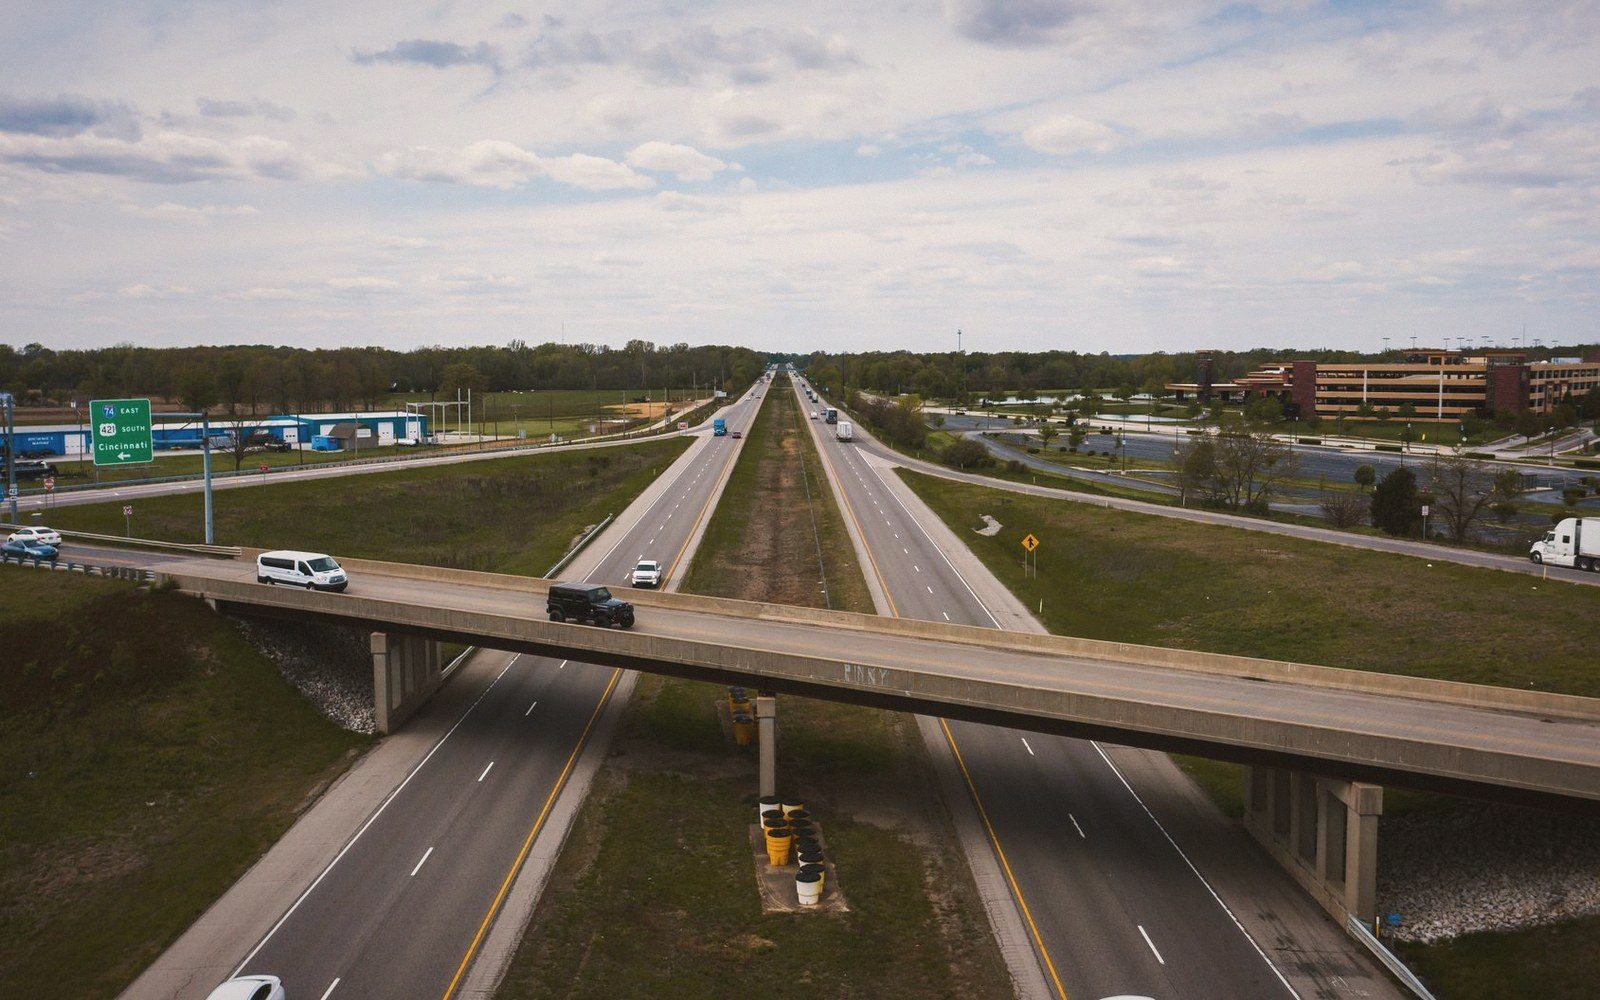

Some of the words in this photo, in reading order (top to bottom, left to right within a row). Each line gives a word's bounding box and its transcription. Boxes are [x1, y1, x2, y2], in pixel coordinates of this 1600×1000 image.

[104, 407, 114, 415] 74
[101, 426, 115, 434] 421
[121, 425, 145, 433] SOUTH
[98, 441, 148, 451] Cincinnati
